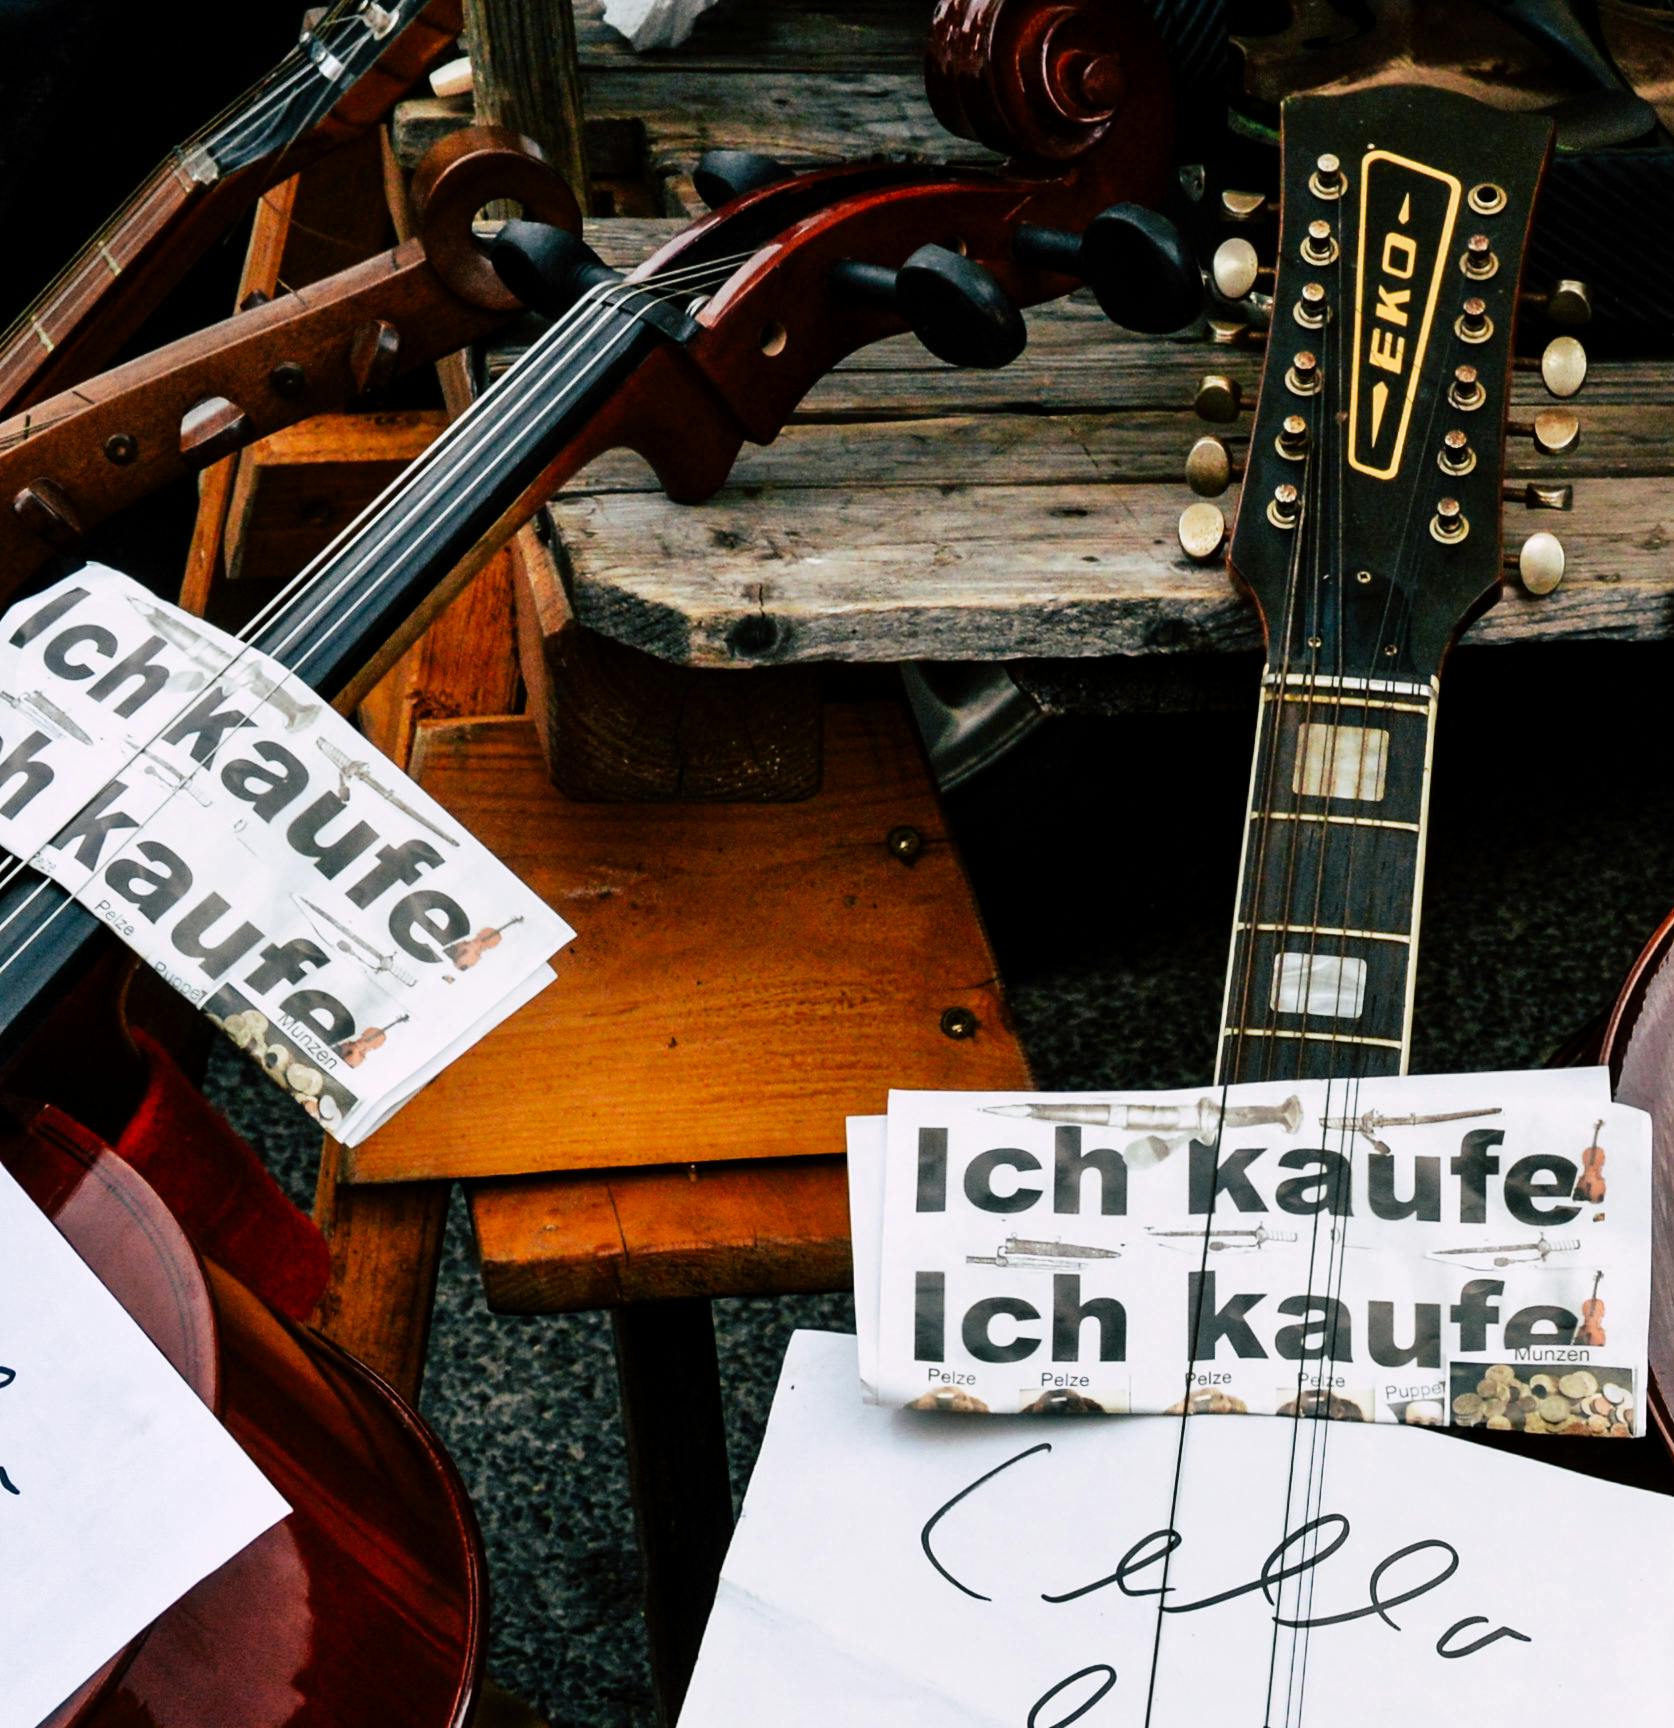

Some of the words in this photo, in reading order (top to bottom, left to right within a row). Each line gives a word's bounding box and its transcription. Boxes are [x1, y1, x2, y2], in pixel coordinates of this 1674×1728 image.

[1369, 231, 1417, 375] EKO
[9, 586, 170, 719] Ich
[162, 685, 470, 964] kaufe
[50, 780, 355, 1047] kaufe
[94, 899, 135, 937] Pelze
[914, 1126, 1129, 1217] Ich
[1188, 1125, 1583, 1226] kaufe
[913, 1270, 1129, 1364] Ich
[1188, 1272, 1580, 1370] kaufe
[926, 1368, 977, 1388] Pelze
[1040, 1370, 1091, 1388] Pelze
[1184, 1368, 1233, 1388] Pelze
[1296, 1369, 1347, 1388] Pelze
